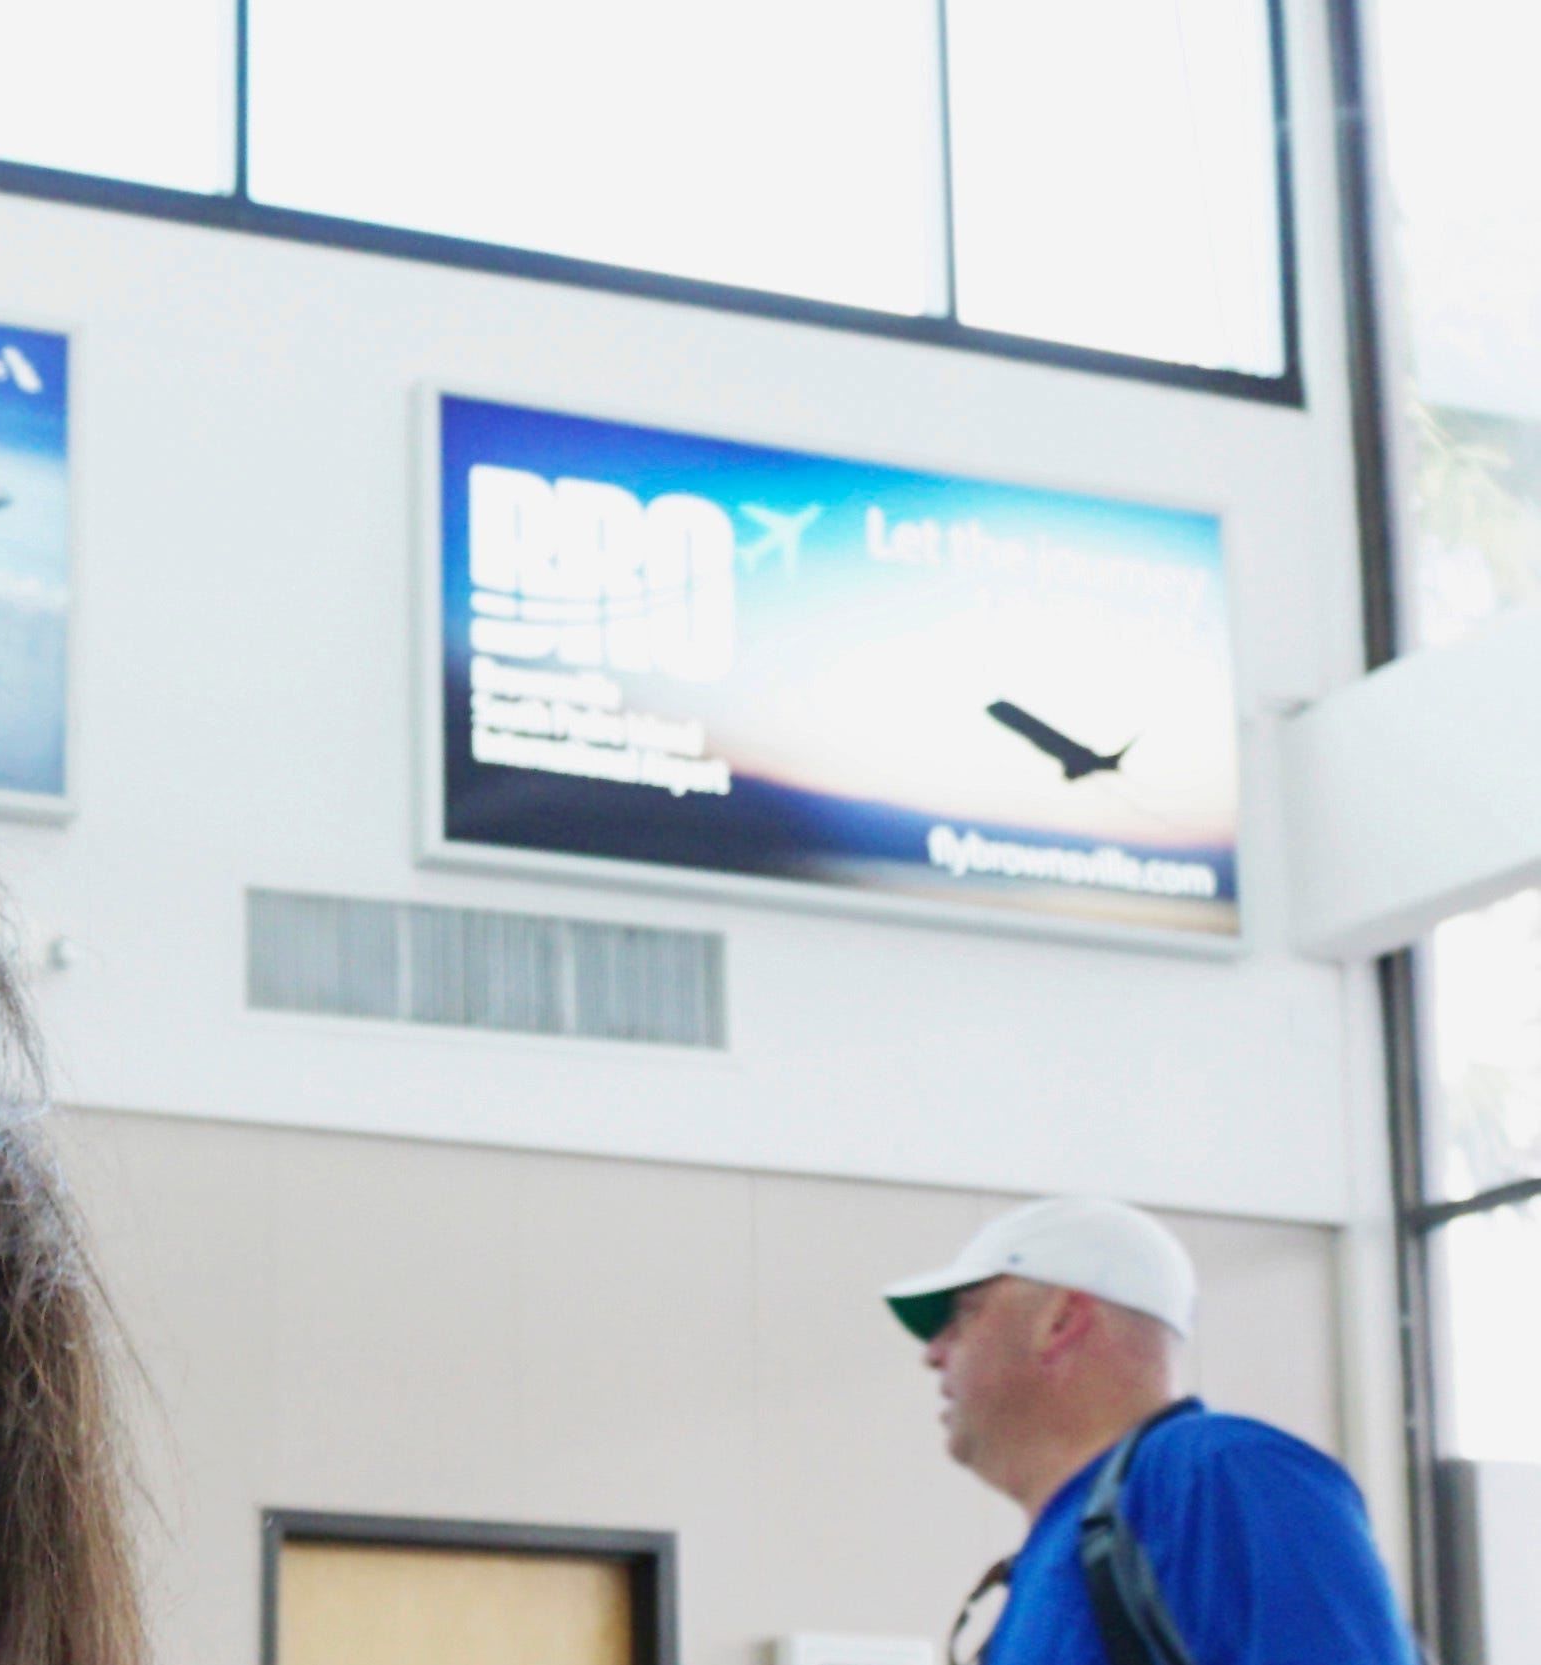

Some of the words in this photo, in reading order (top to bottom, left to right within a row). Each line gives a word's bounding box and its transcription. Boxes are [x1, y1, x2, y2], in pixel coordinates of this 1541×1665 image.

[865, 505, 942, 566] Let
[948, 520, 1028, 574] the
[926, 823, 1218, 899] flybrownsville.com
